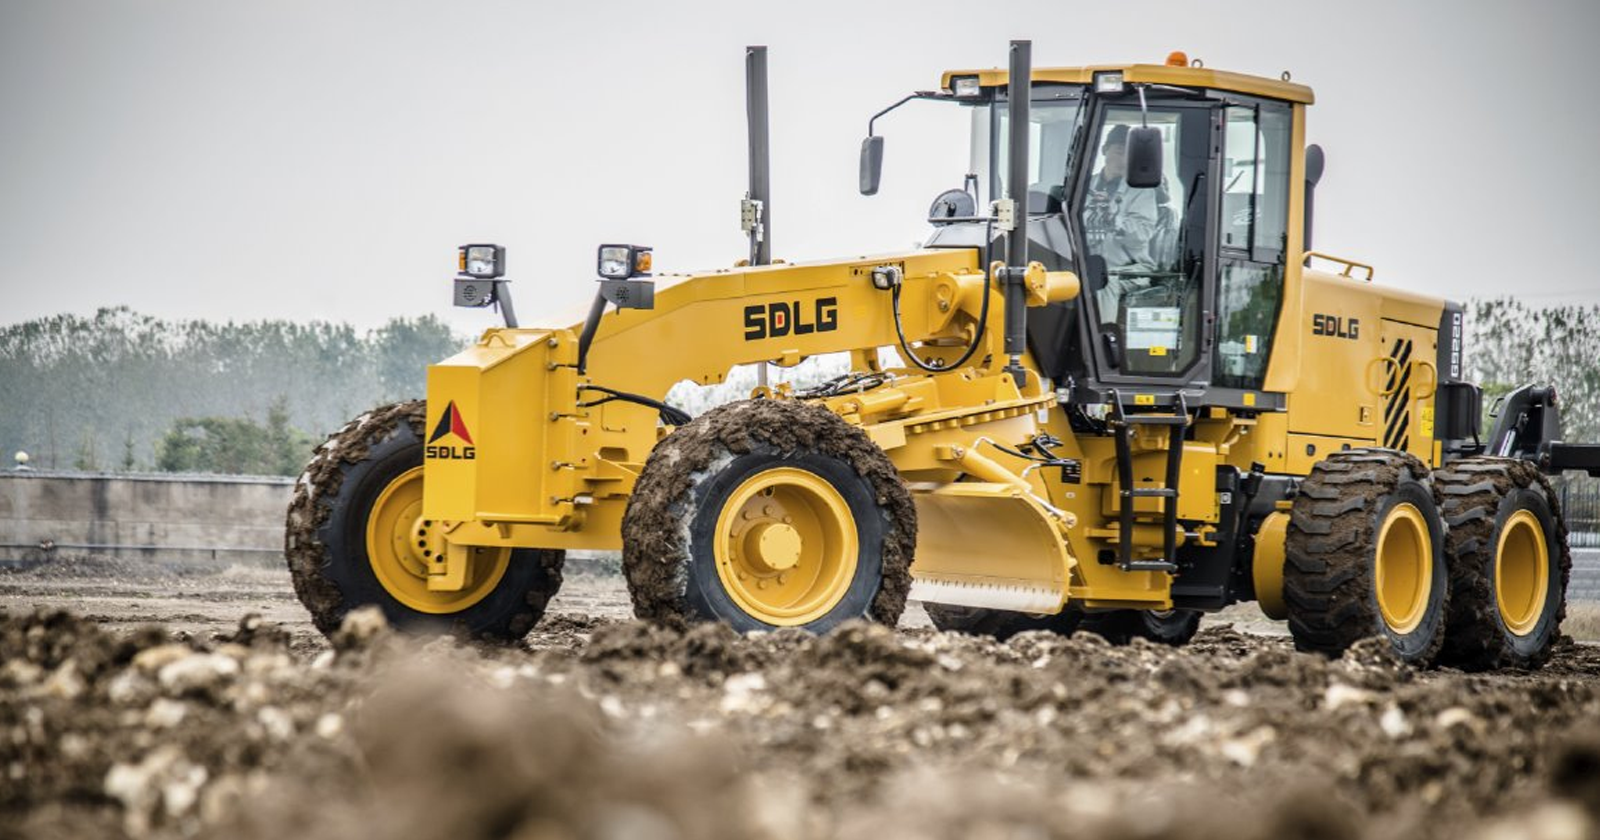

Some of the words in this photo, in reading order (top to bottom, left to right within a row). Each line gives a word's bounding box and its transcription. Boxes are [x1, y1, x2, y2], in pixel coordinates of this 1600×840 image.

[744, 297, 837, 341] SDLG
[1313, 313, 1359, 340] SDLG
[1450, 312, 1461, 378] G9220
[426, 446, 475, 460] SDLG
